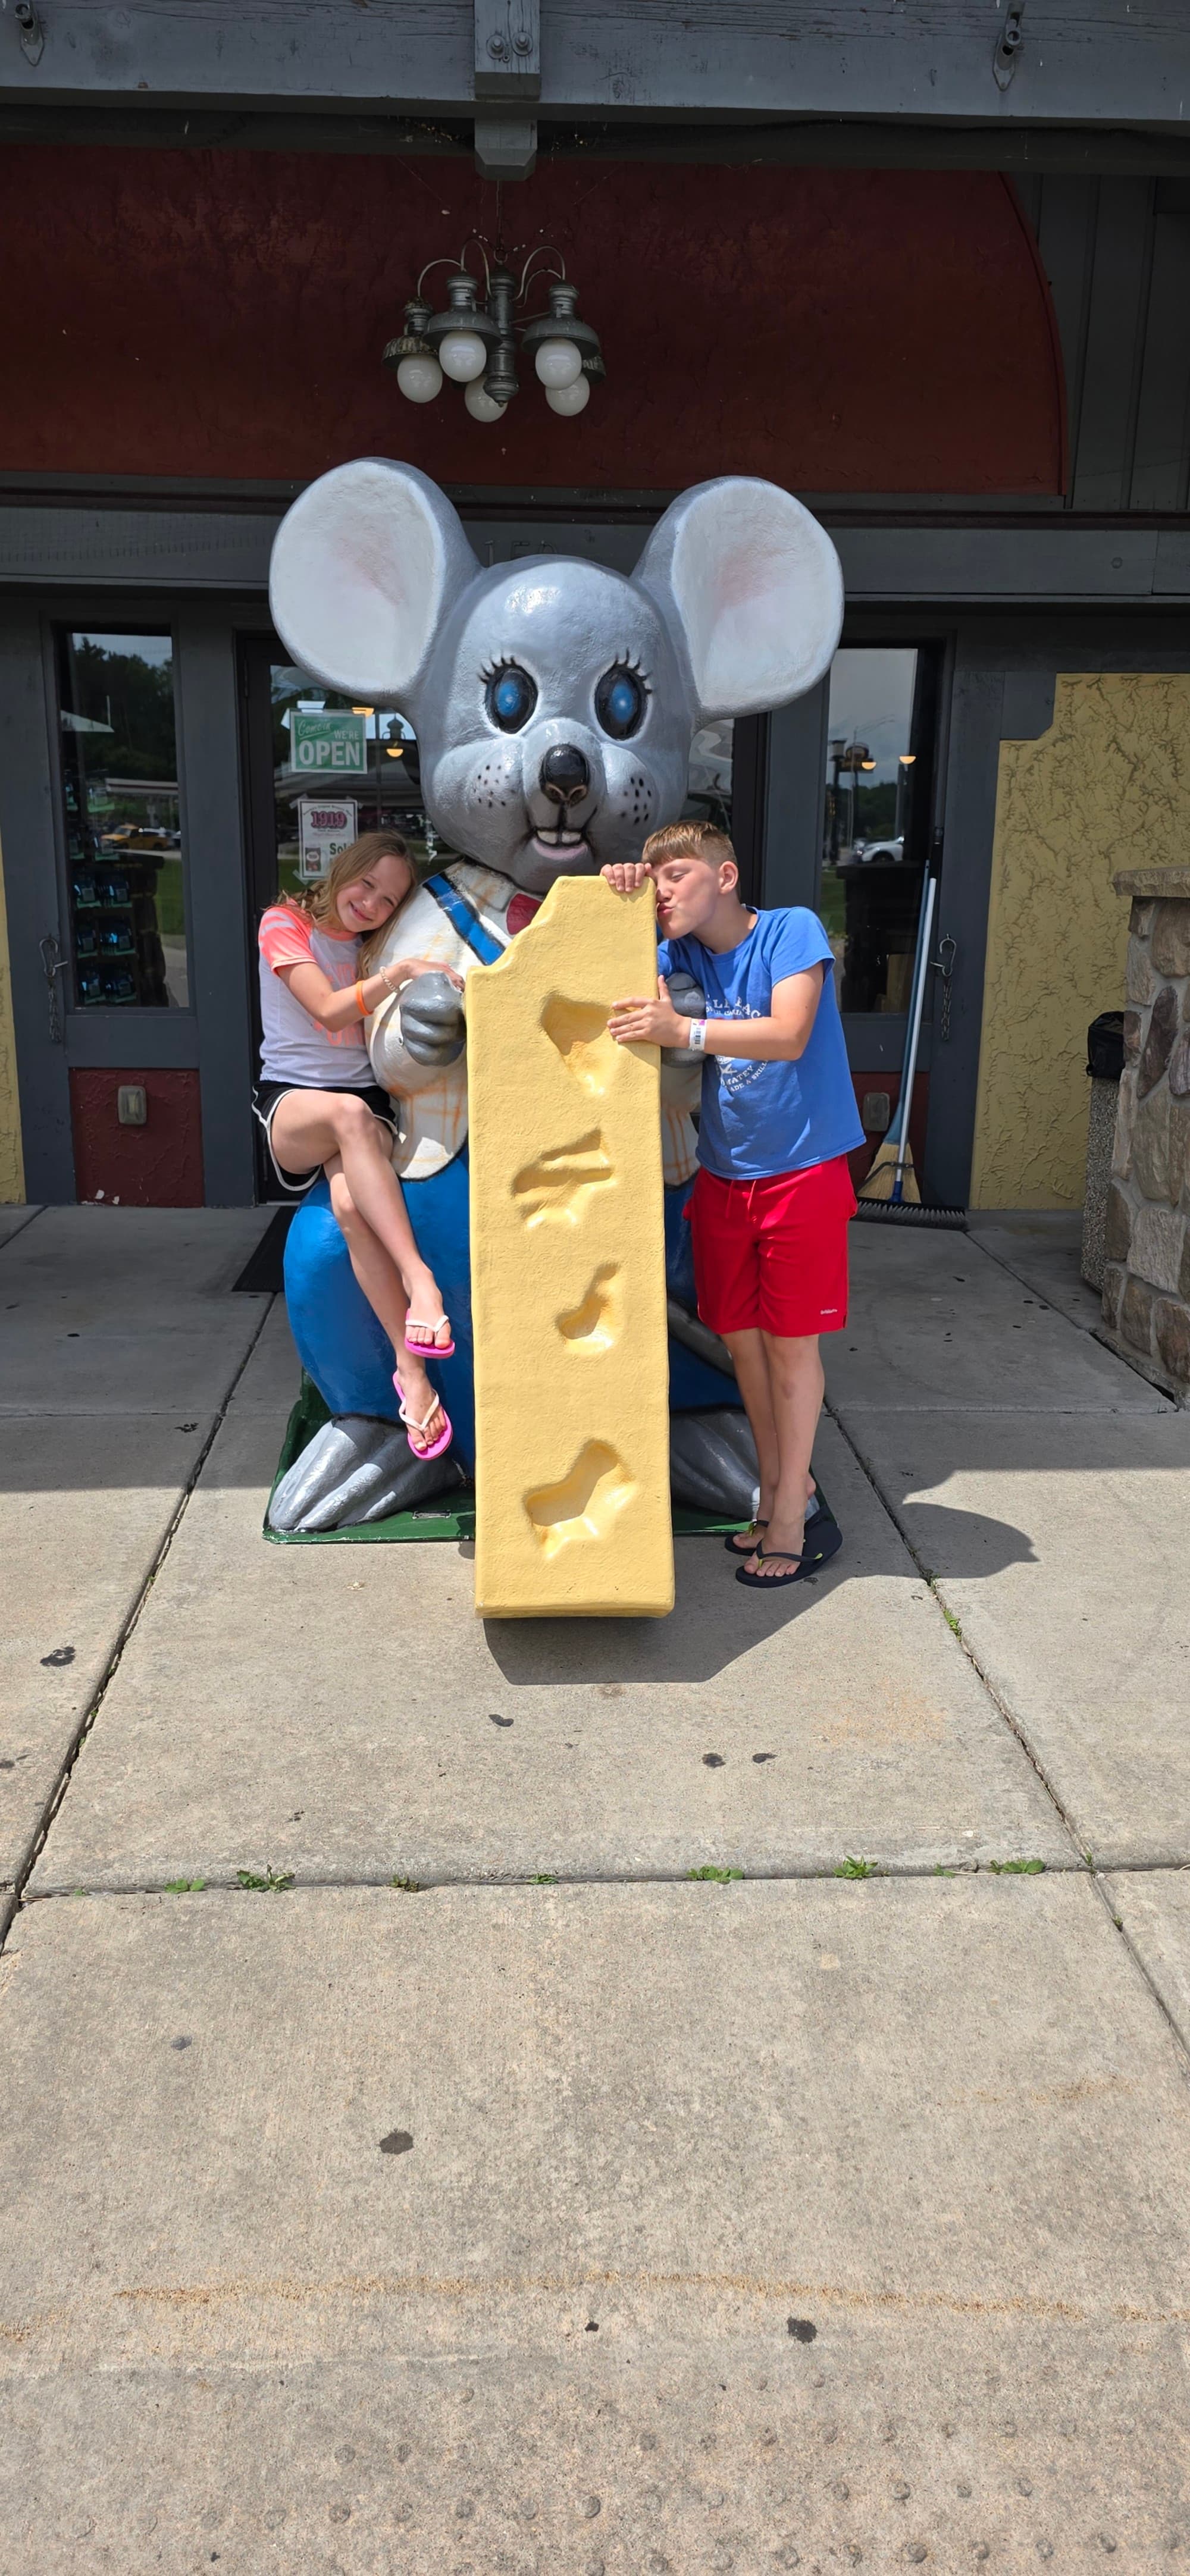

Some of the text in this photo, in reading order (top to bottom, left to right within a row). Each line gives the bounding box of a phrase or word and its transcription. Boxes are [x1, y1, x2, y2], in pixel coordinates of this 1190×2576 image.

[298, 719, 321, 737] Come
[334, 729, 359, 739] WE'RE
[299, 739, 361, 766] OPEN
[311, 810, 347, 830] 1919
[330, 842, 353, 855] Sol
[730, 1083, 744, 1092] ADE
[751, 1060, 768, 1080] SKILL
